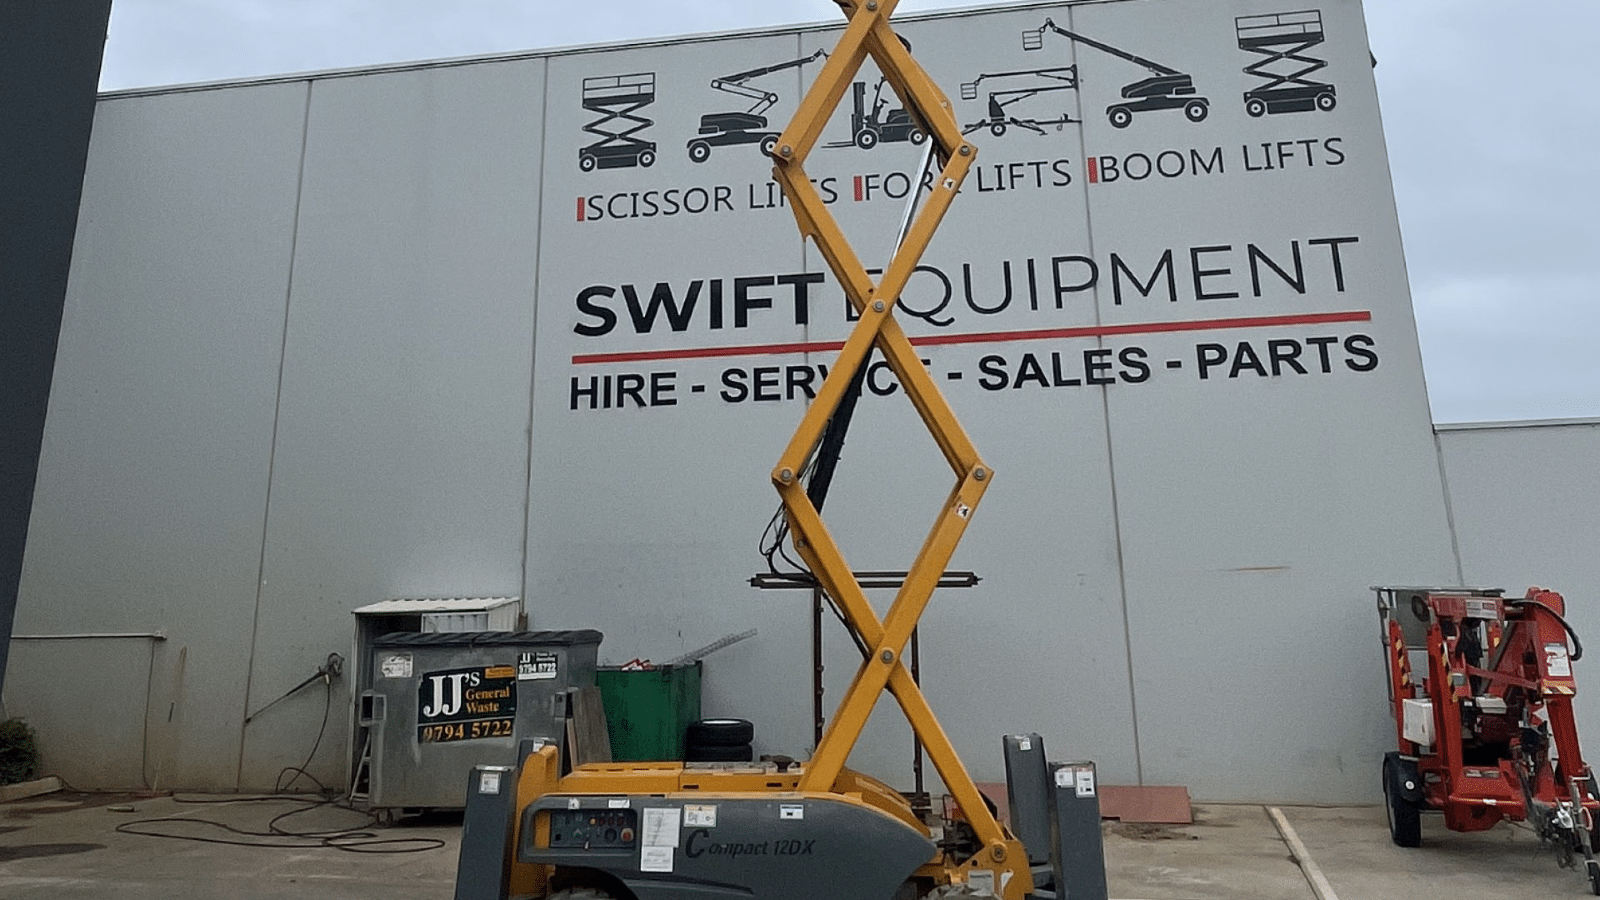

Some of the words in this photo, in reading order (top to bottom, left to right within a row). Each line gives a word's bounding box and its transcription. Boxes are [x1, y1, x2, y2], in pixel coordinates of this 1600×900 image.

[587, 187, 734, 221] SCISSOR
[977, 159, 1072, 192] LIFTS
[1101, 147, 1224, 183] BOOM
[1242, 137, 1345, 171] LIFTS
[574, 272, 826, 337] SWIFT
[570, 371, 678, 411] HIRE
[979, 346, 1151, 391] SALES
[1197, 334, 1379, 380] PARTS
[465, 685, 511, 701] General
[465, 701, 500, 714] Waste
[423, 723, 465, 741] 9794
[471, 720, 512, 738] 5722
[685, 828, 768, 859] Compact
[773, 839, 817, 857] 12DX
